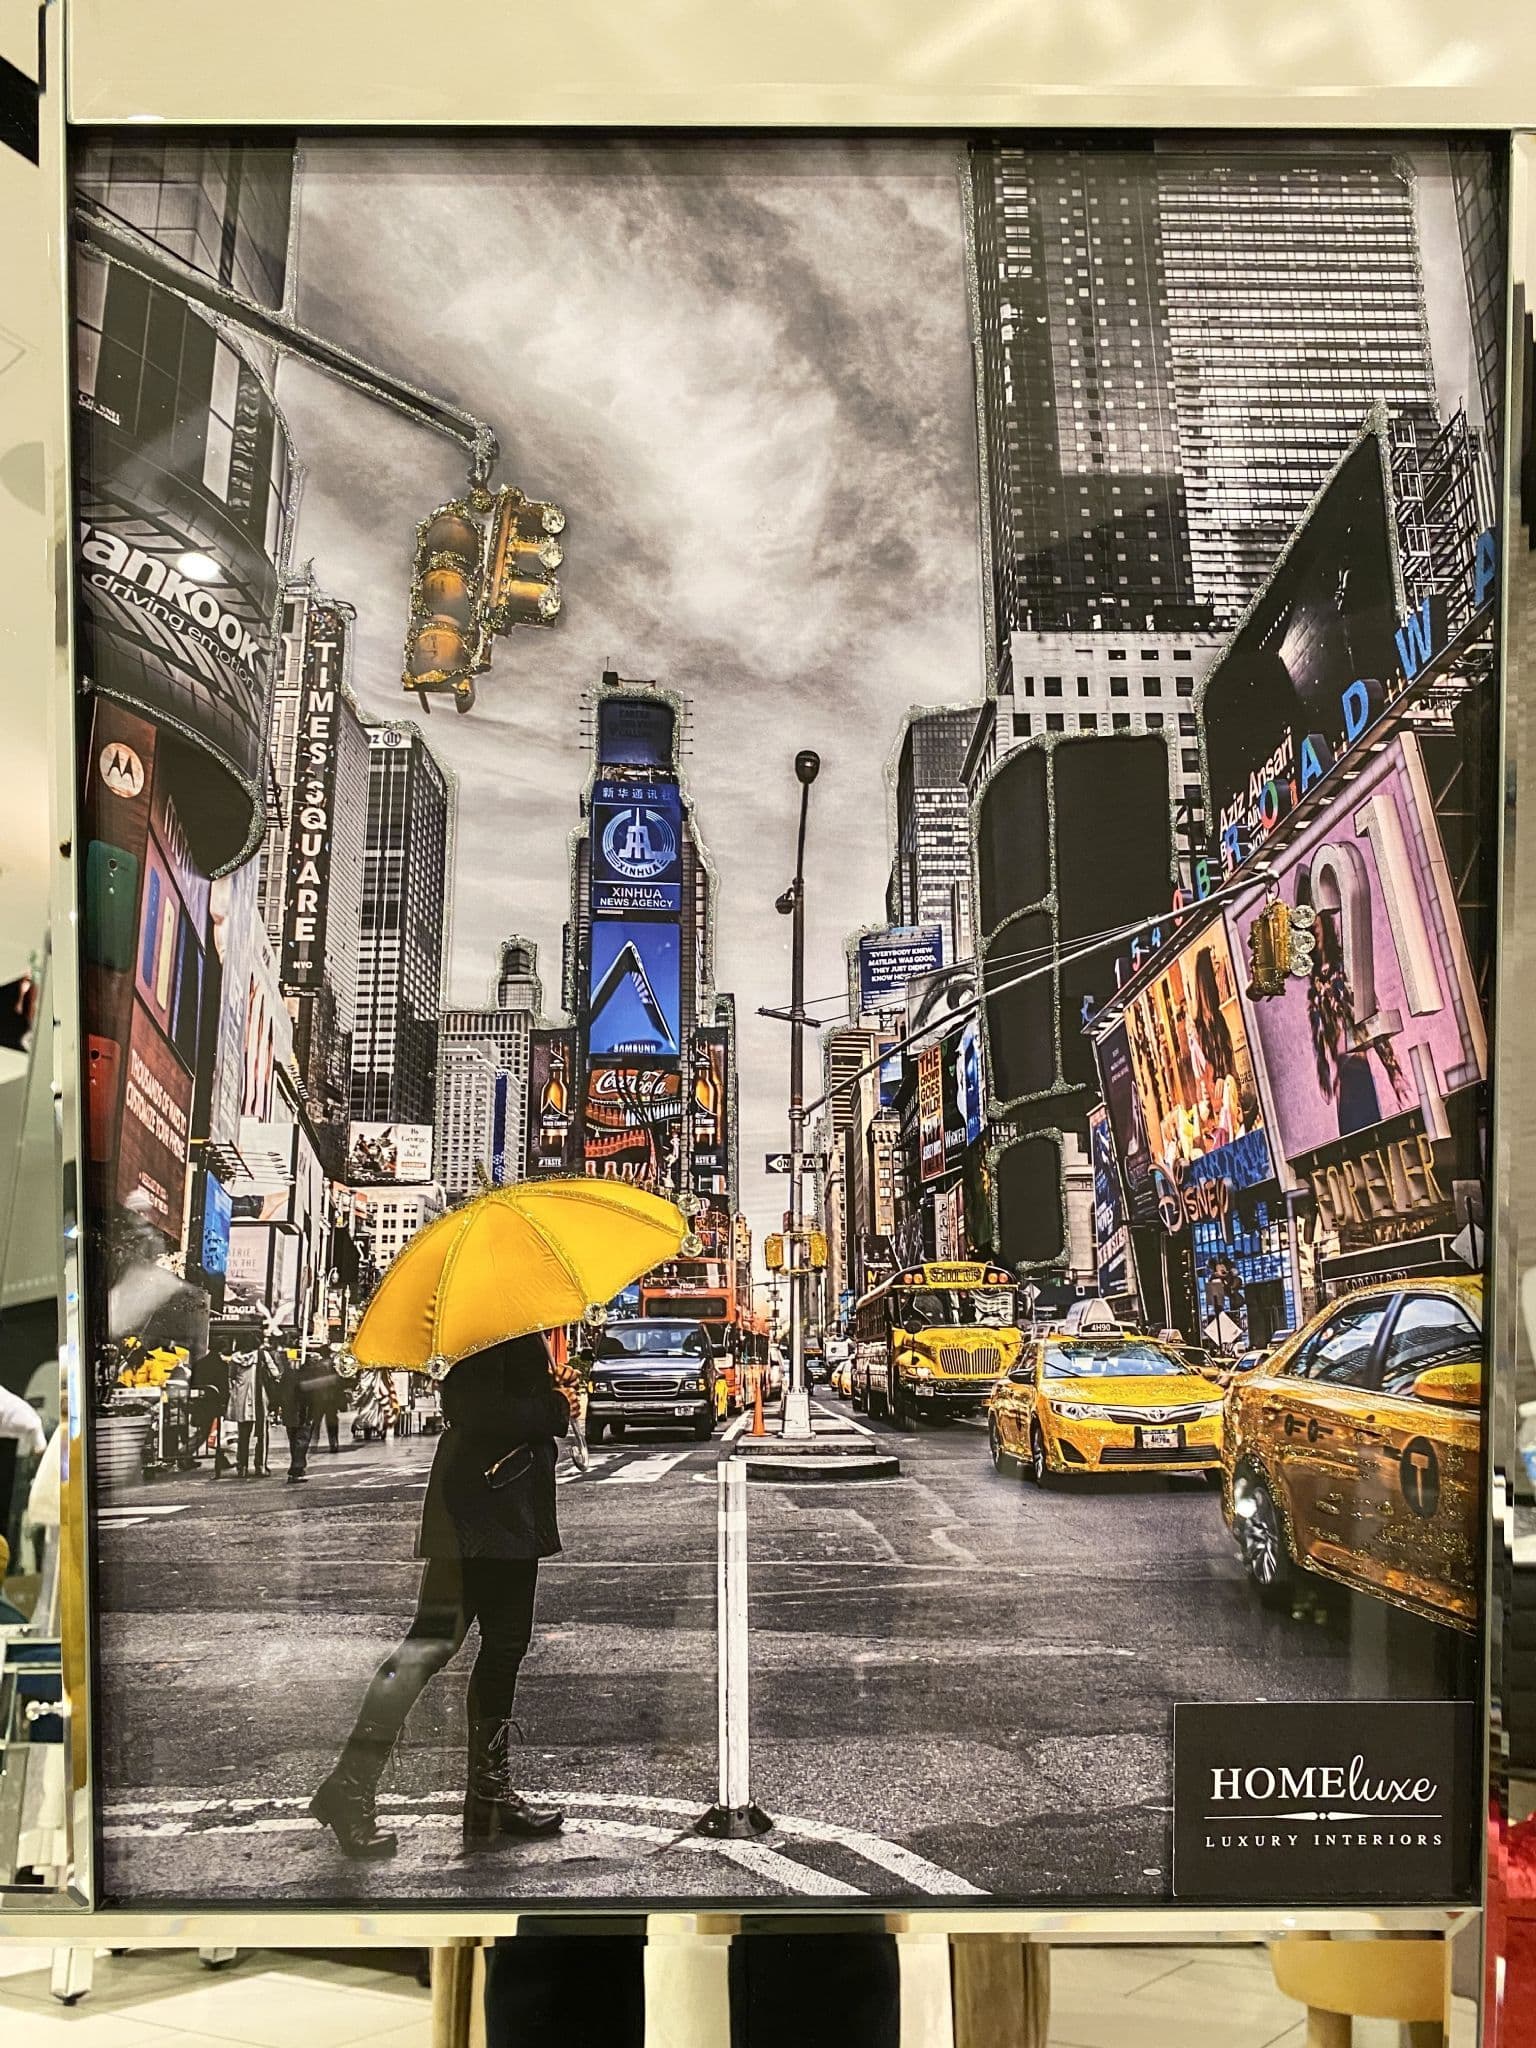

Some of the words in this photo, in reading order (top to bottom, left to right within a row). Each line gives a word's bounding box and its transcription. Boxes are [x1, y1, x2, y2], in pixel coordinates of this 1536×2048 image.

[81, 521, 259, 673] ankook
[91, 574, 184, 630] driving
[189, 625, 255, 688] emotion
[309, 642, 336, 764] TIMES
[1219, 792, 1246, 841] Aziz
[1248, 726, 1294, 806] Ansari
[295, 781, 327, 942] SQUARE
[616, 861, 662, 877] XINHUA
[600, 897, 629, 908] NEWS
[631, 898, 673, 909] AGENCY
[612, 887, 662, 899] XINHUA
[868, 957, 897, 966] MATILDA
[898, 955, 913, 964] WAS
[872, 966, 889, 974] THEY
[890, 964, 907, 972] JUST
[871, 973, 893, 982] KNOW
[920, 1047, 939, 1075] THE
[131, 1048, 163, 1106] THOUSANDS
[920, 1068, 939, 1087] CROWD
[920, 1080, 940, 1101] GOES
[1311, 1133, 1446, 1232] FOREVER
[1091, 1322, 1111, 1332] 4H90
[1210, 1754, 1438, 1803] HOMEluxe
[1205, 1835, 1299, 1848] LUXURY
[1314, 1834, 1443, 1846] INTERIORS
